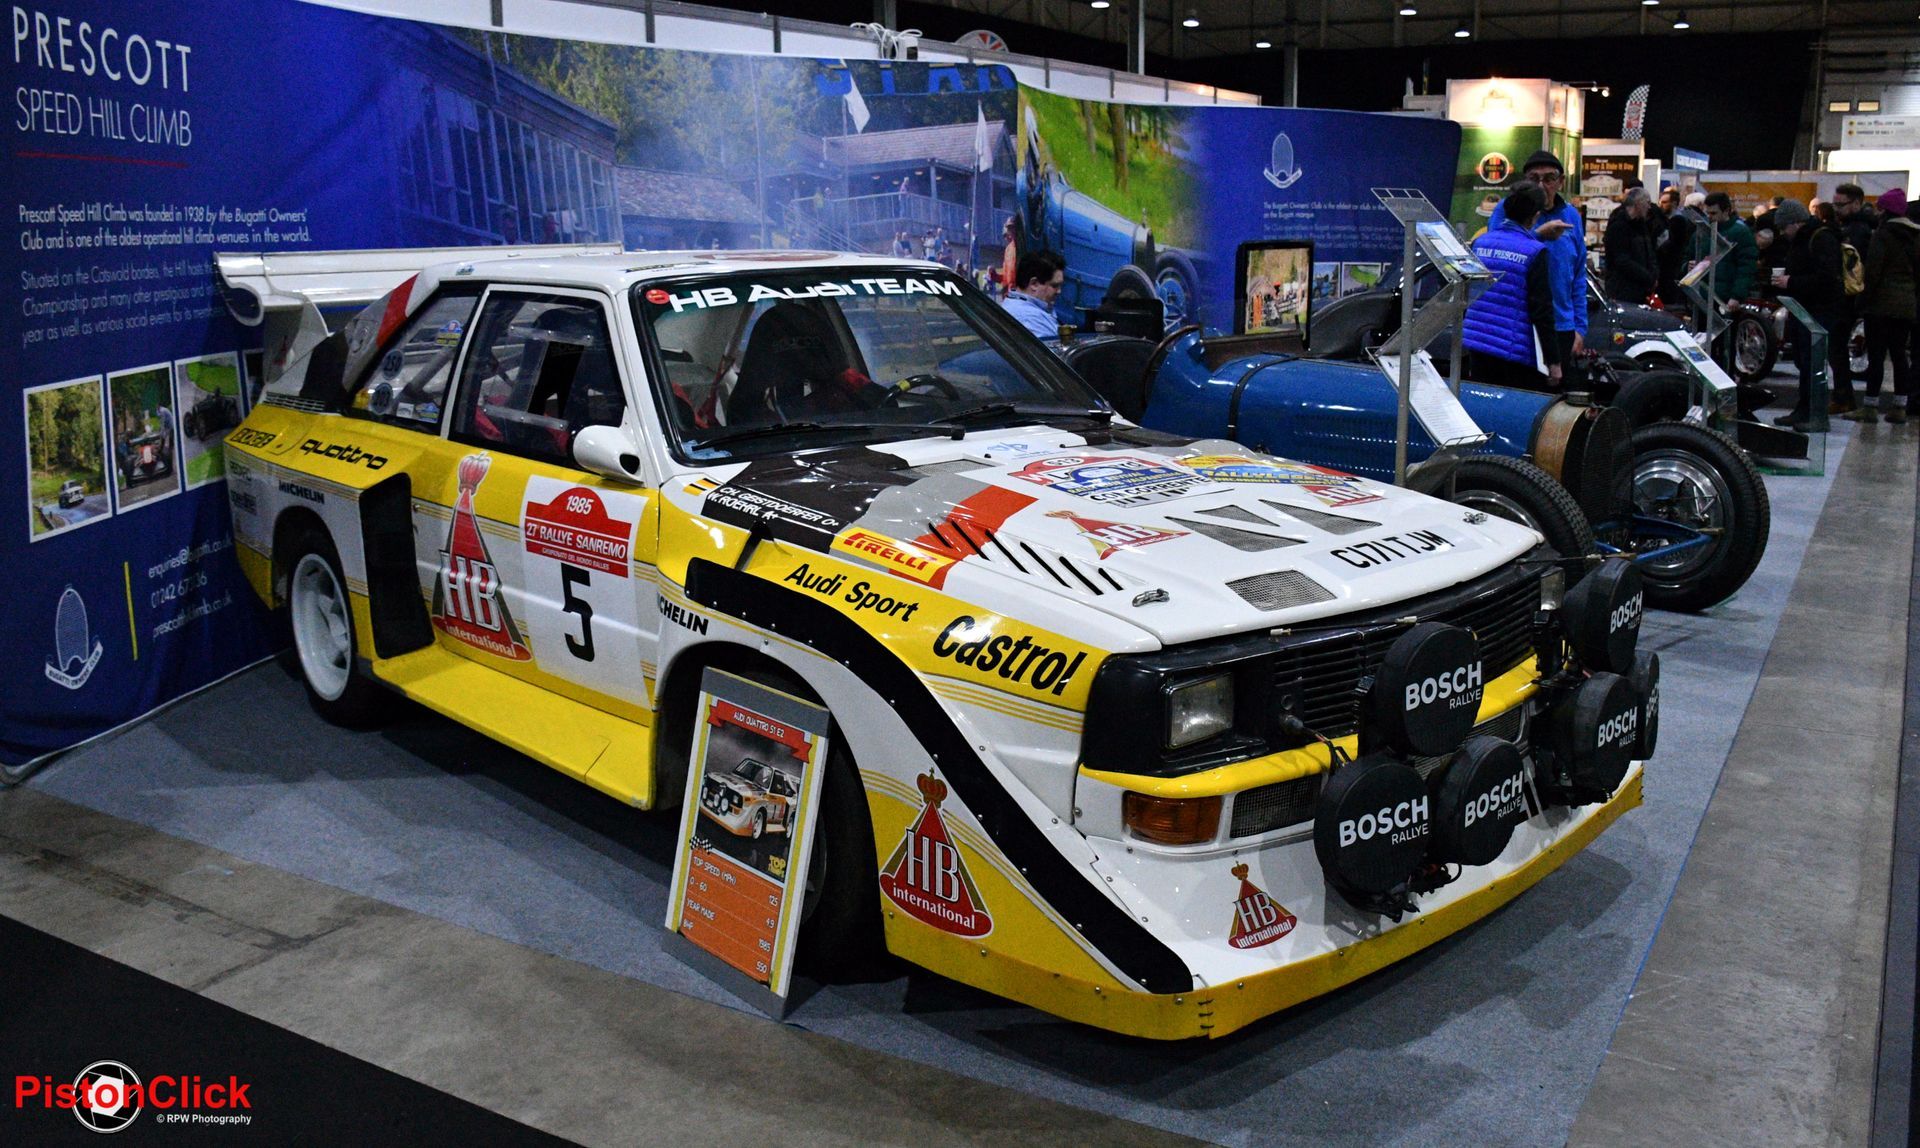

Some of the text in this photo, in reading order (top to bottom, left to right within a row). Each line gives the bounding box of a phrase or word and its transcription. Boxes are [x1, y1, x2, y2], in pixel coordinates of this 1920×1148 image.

[13, 6, 192, 92] PRESCOTT
[16, 87, 192, 147] SPEED HILL CLIMB
[19, 204, 56, 222] Prescott
[57, 202, 86, 227] Speed
[87, 202, 101, 221] Hill
[103, 202, 127, 221] Climb
[129, 209, 144, 221] was
[145, 203, 174, 222] founded
[175, 206, 182, 221] in
[184, 206, 205, 222] 1938
[206, 205, 216, 226] by
[219, 205, 233, 221] the
[235, 207, 267, 227] Bugatti
[21, 229, 43, 250] Club
[45, 228, 64, 248] and
[66, 230, 74, 247] is
[76, 234, 92, 247] one
[94, 227, 103, 246] of
[105, 227, 117, 246] the
[119, 227, 141, 246] oldest
[195, 226, 214, 243] climb
[217, 233, 250, 243] venues
[252, 229, 261, 243] in
[264, 227, 279, 242] the
[669, 287, 737, 312] HB
[300, 439, 388, 470] quattro
[279, 480, 324, 504] MICHELIN
[566, 496, 595, 515] 1985
[540, 526, 573, 546] RALLYE
[576, 535, 626, 559] SANREMO
[843, 531, 937, 572] PIRELLI
[439, 550, 501, 632] HB
[784, 564, 920, 623] Audi Sport
[561, 563, 595, 662] 5
[1610, 590, 1643, 634] BOSCH
[446, 621, 517, 658] international
[932, 615, 1088, 697] Castrol
[1405, 660, 1482, 711] BOSCH
[1449, 688, 1482, 710] RALLYE
[746, 716, 769, 732] QUATTRO
[1598, 706, 1638, 748] BOSCH
[1618, 730, 1637, 748] RALLYE
[1464, 770, 1524, 828] BOSCH
[1496, 794, 1522, 820] RALLYE
[1339, 795, 1430, 848] BOSCH
[1391, 822, 1430, 845] RALLYE
[693, 856, 703, 867] TOP
[704, 863, 720, 877] SPEED
[905, 828, 960, 902] HB
[686, 899, 716, 921] YEAR MADE
[893, 883, 975, 930] international
[1232, 892, 1277, 933] HB
[1236, 919, 1293, 949] international
